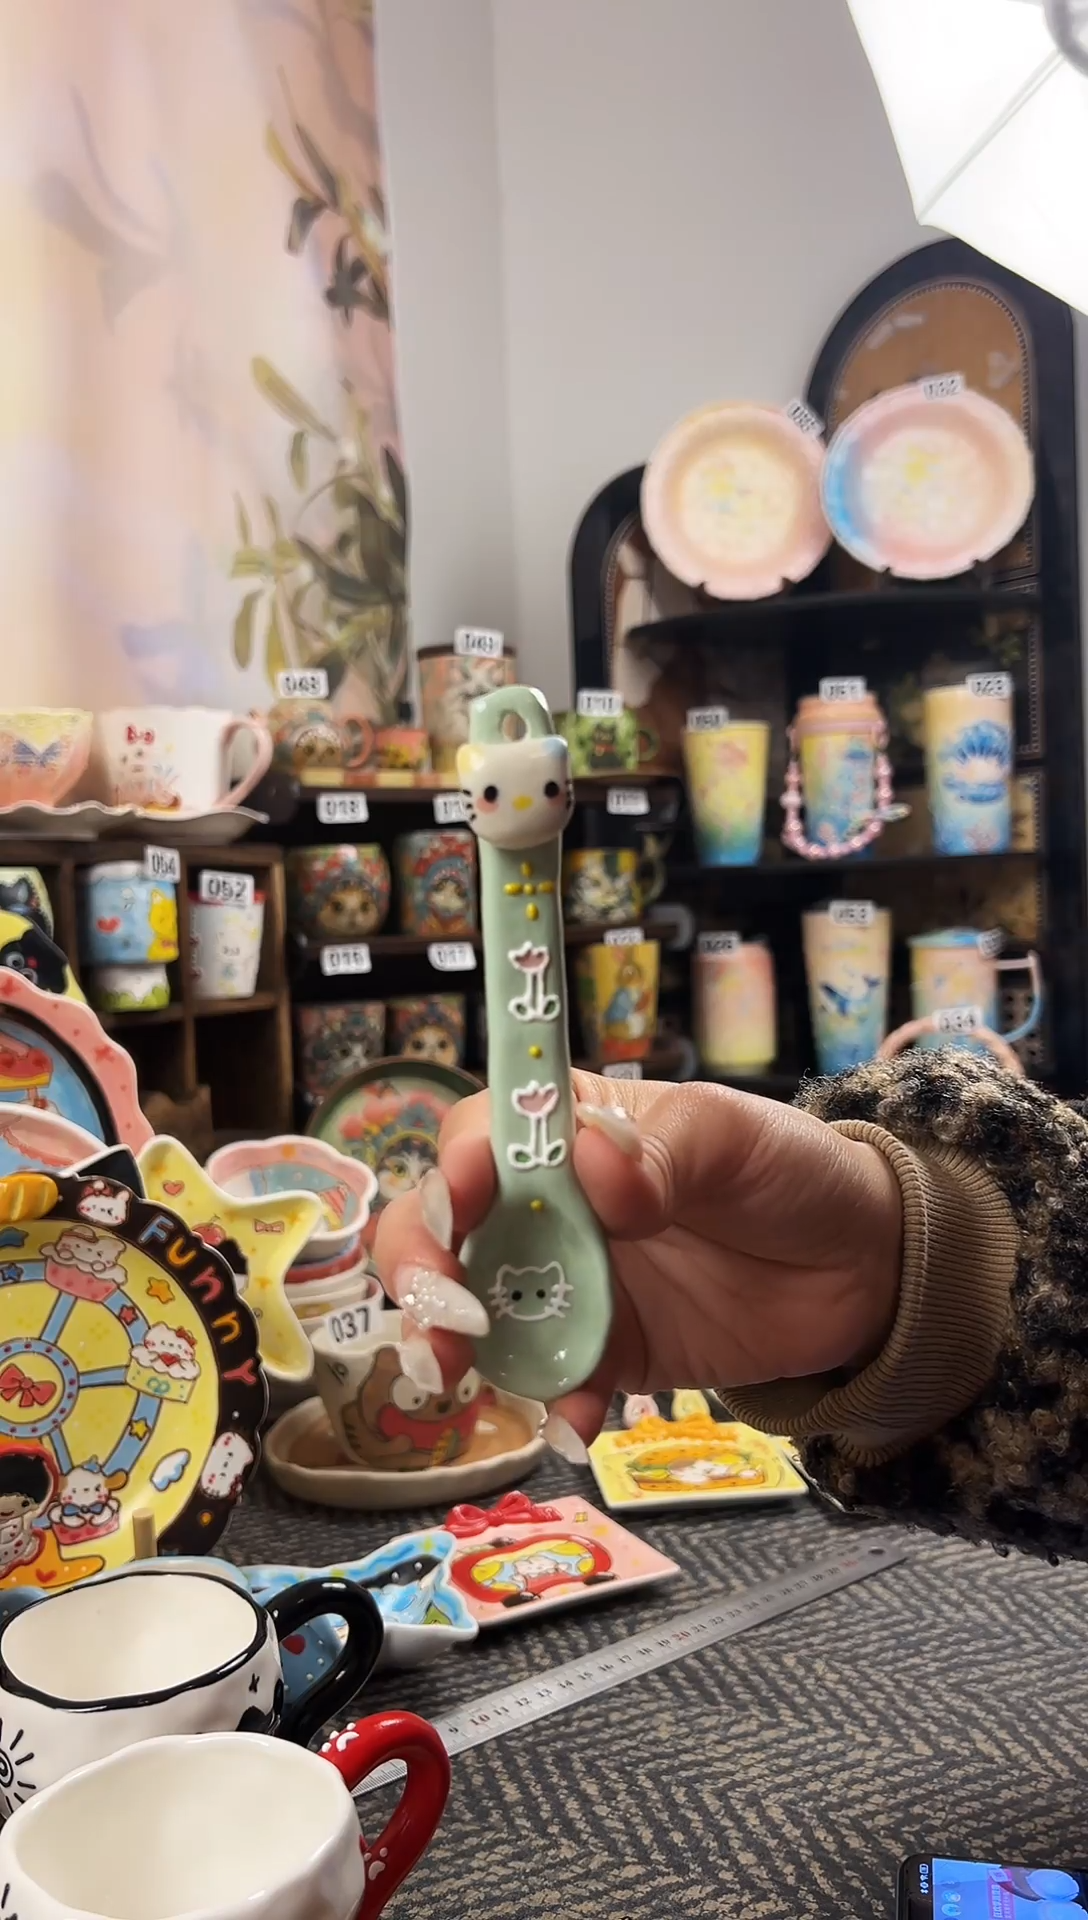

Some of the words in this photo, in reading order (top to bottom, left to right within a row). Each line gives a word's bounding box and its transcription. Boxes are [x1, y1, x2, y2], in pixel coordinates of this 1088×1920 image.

[208, 879, 247, 899] 052
[331, 1305, 370, 1342] 037
[469, 1714, 490, 1726] 10
[493, 1706, 510, 1716] 11
[515, 1697, 532, 1707] 12
[558, 1680, 574, 1689] 14
